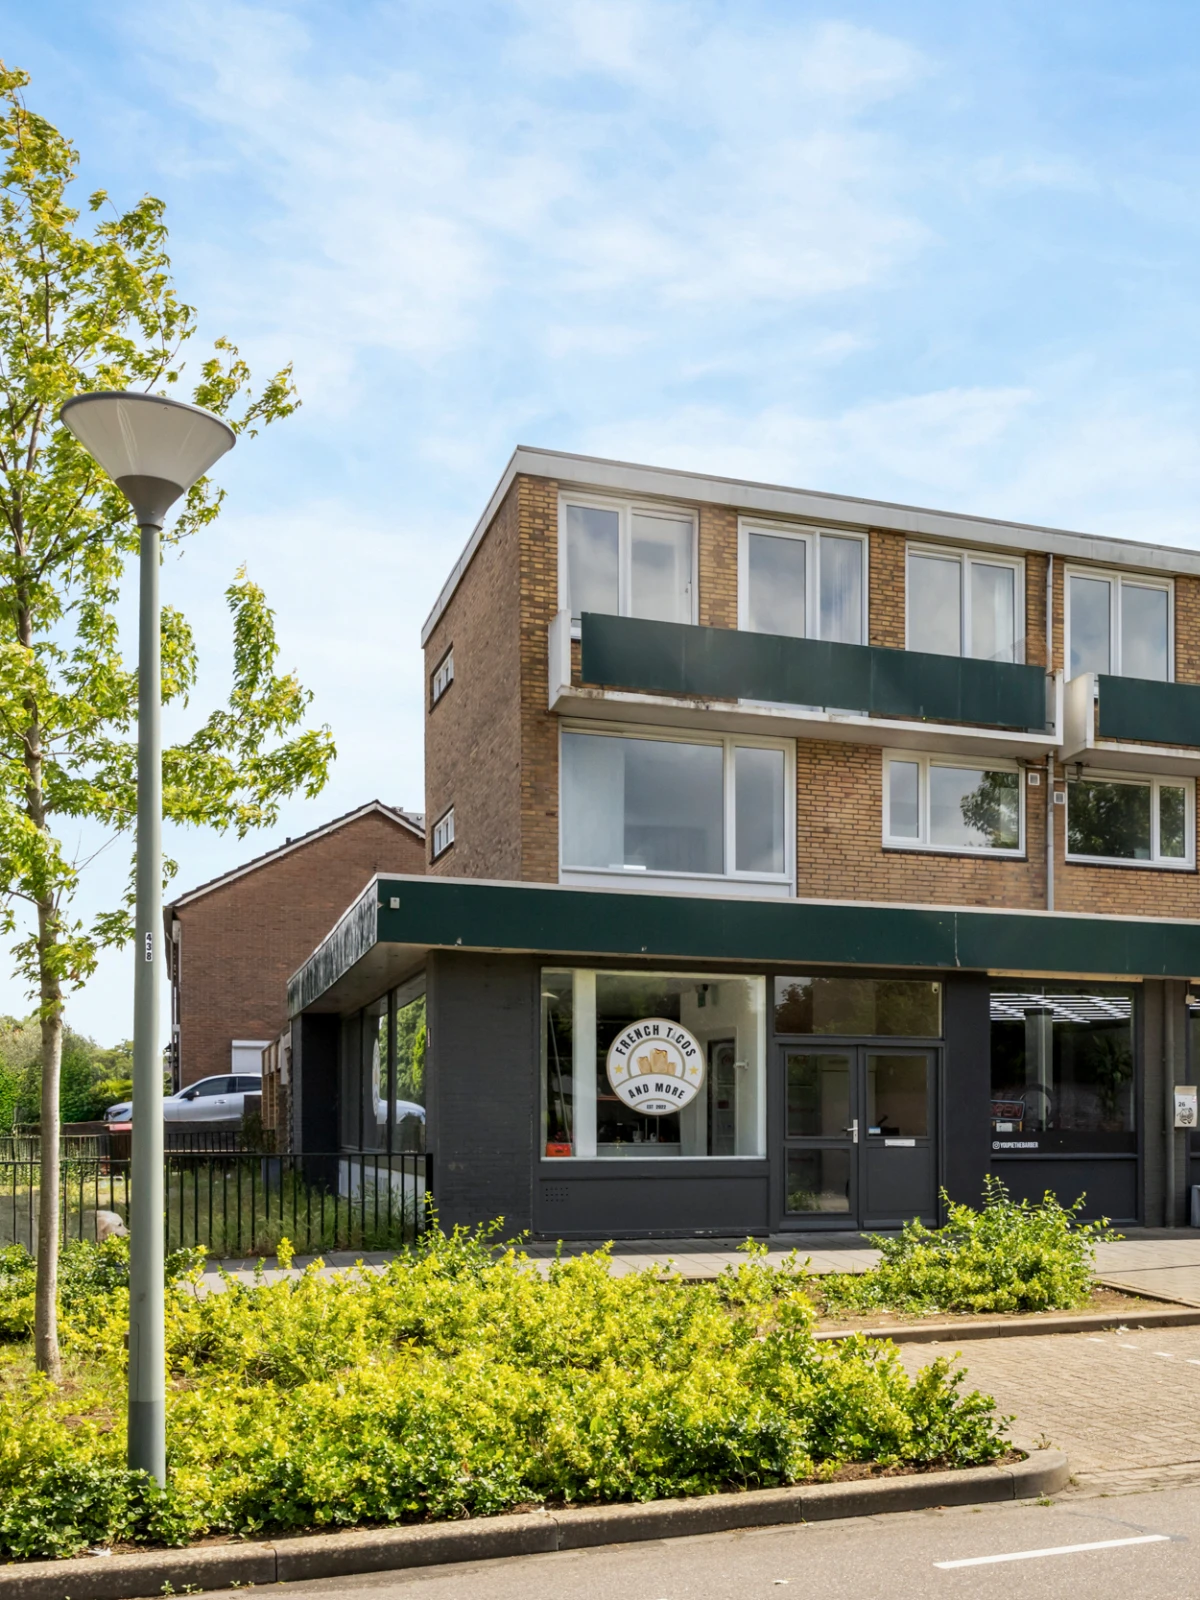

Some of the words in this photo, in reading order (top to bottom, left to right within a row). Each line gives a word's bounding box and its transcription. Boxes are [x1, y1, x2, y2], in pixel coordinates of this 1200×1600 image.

[615, 1024, 660, 1056] FRENCH
[666, 1027, 697, 1057] TACOS
[628, 1083, 649, 1099] AND
[655, 1083, 685, 1099] MORE
